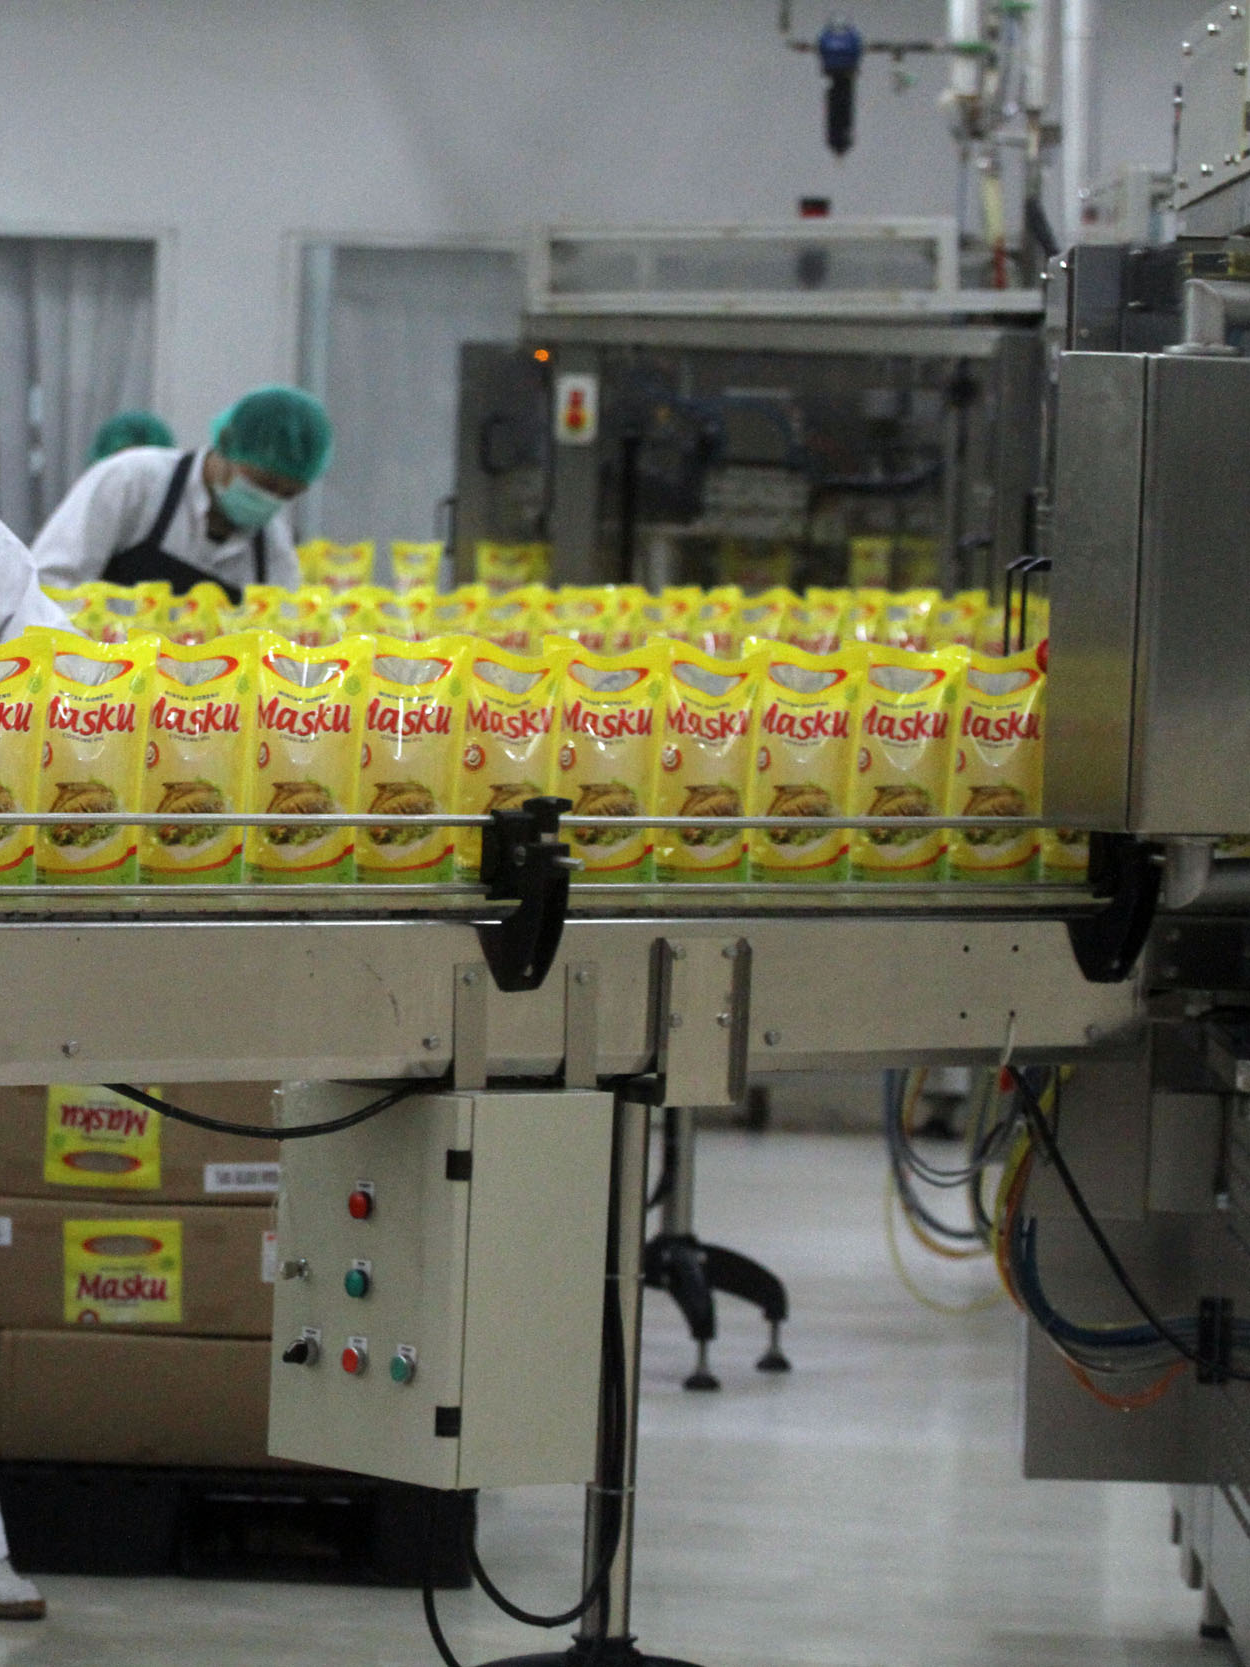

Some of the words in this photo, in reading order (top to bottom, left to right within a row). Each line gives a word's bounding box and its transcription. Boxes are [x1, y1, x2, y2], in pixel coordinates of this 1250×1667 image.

[257, 694, 351, 736] Masku
[466, 699, 556, 738] Masku
[561, 700, 653, 738] Masku
[61, 1104, 148, 1137] Masku
[76, 1273, 168, 1301] Masku
